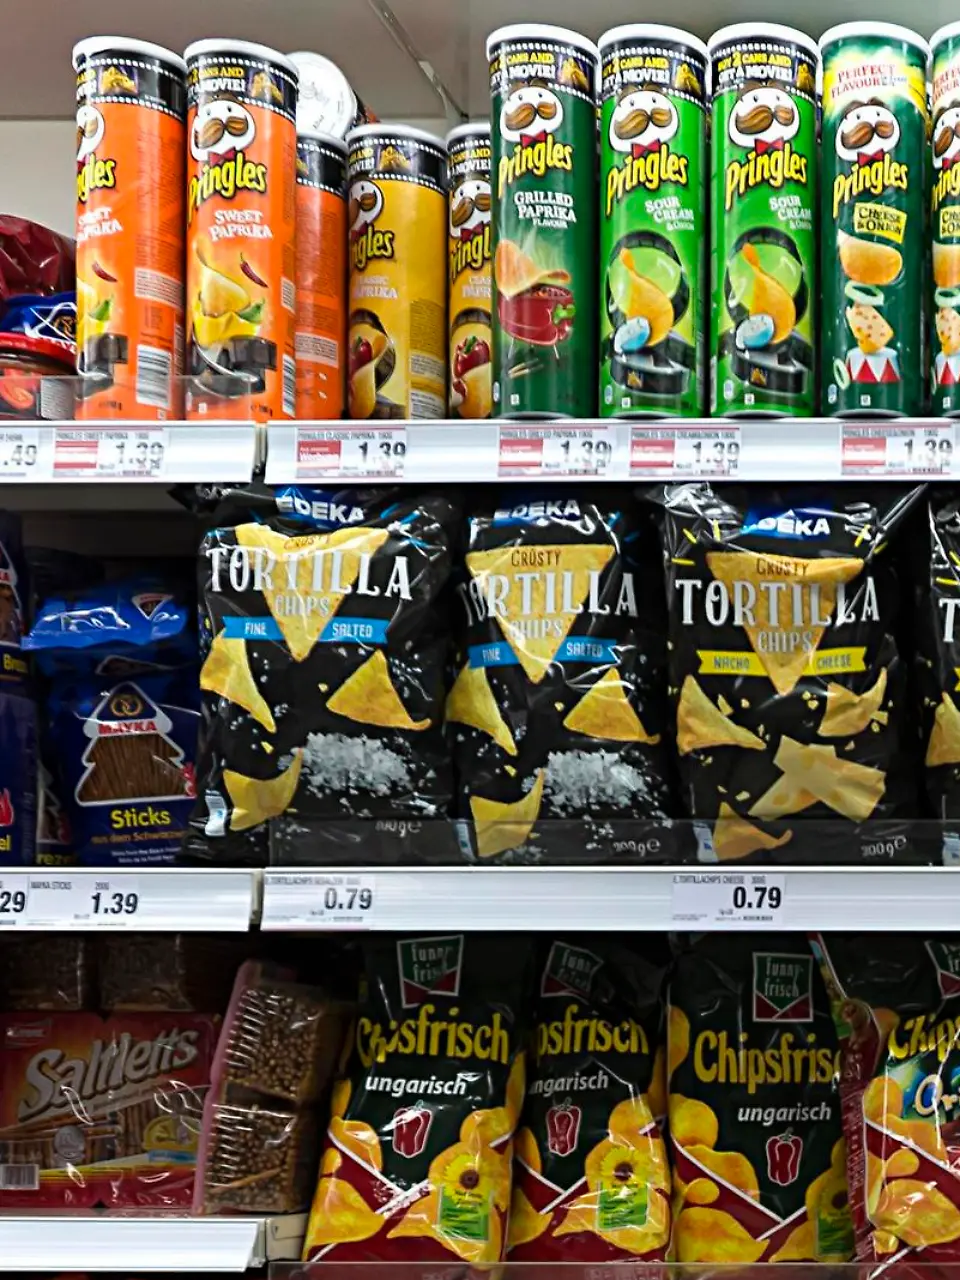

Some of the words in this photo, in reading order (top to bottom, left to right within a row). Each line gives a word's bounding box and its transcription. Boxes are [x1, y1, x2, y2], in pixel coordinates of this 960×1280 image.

[498, 134, 573, 200] Pringles
[726, 142, 807, 212] Pringles
[188, 152, 268, 227] Pringles
[606, 143, 688, 217] Pringles
[833, 153, 909, 219] Pringles
[514, 191, 574, 208] GRILLED
[645, 197, 681, 213] SOUR
[769, 196, 803, 211] SOUR
[215, 209, 263, 224] SWEET
[518, 205, 577, 222] PAPRIKA
[653, 209, 694, 223] CREAM
[858, 207, 901, 228] CHEESE
[208, 222, 274, 242] PAPRIKA
[866, 221, 902, 237] ONION
[693, 441, 740, 463] 1.39
[276, 495, 366, 524] EDEKA
[511, 548, 561, 567] CRUSTY
[756, 558, 810, 577] CRUSTY
[206, 545, 412, 600] TORTILLA
[458, 571, 638, 627] TORTILLA
[675, 577, 881, 627] TORTILLA
[245, 622, 267, 636] FINE
[332, 624, 373, 639] SALTED
[566, 642, 604, 659] SALTED
[757, 631, 813, 653] CHIPS
[713, 657, 750, 670] NACHO
[816, 654, 853, 670] CHEESE
[98, 719, 159, 735] MAYKA
[110, 806, 171, 829] Sticks
[91, 892, 138, 915] 1.39
[324, 888, 373, 910] 0.79
[733, 886, 782, 909] 0.79
[365, 1074, 467, 1096] ungarisch
[737, 1103, 832, 1127] ungarisch
